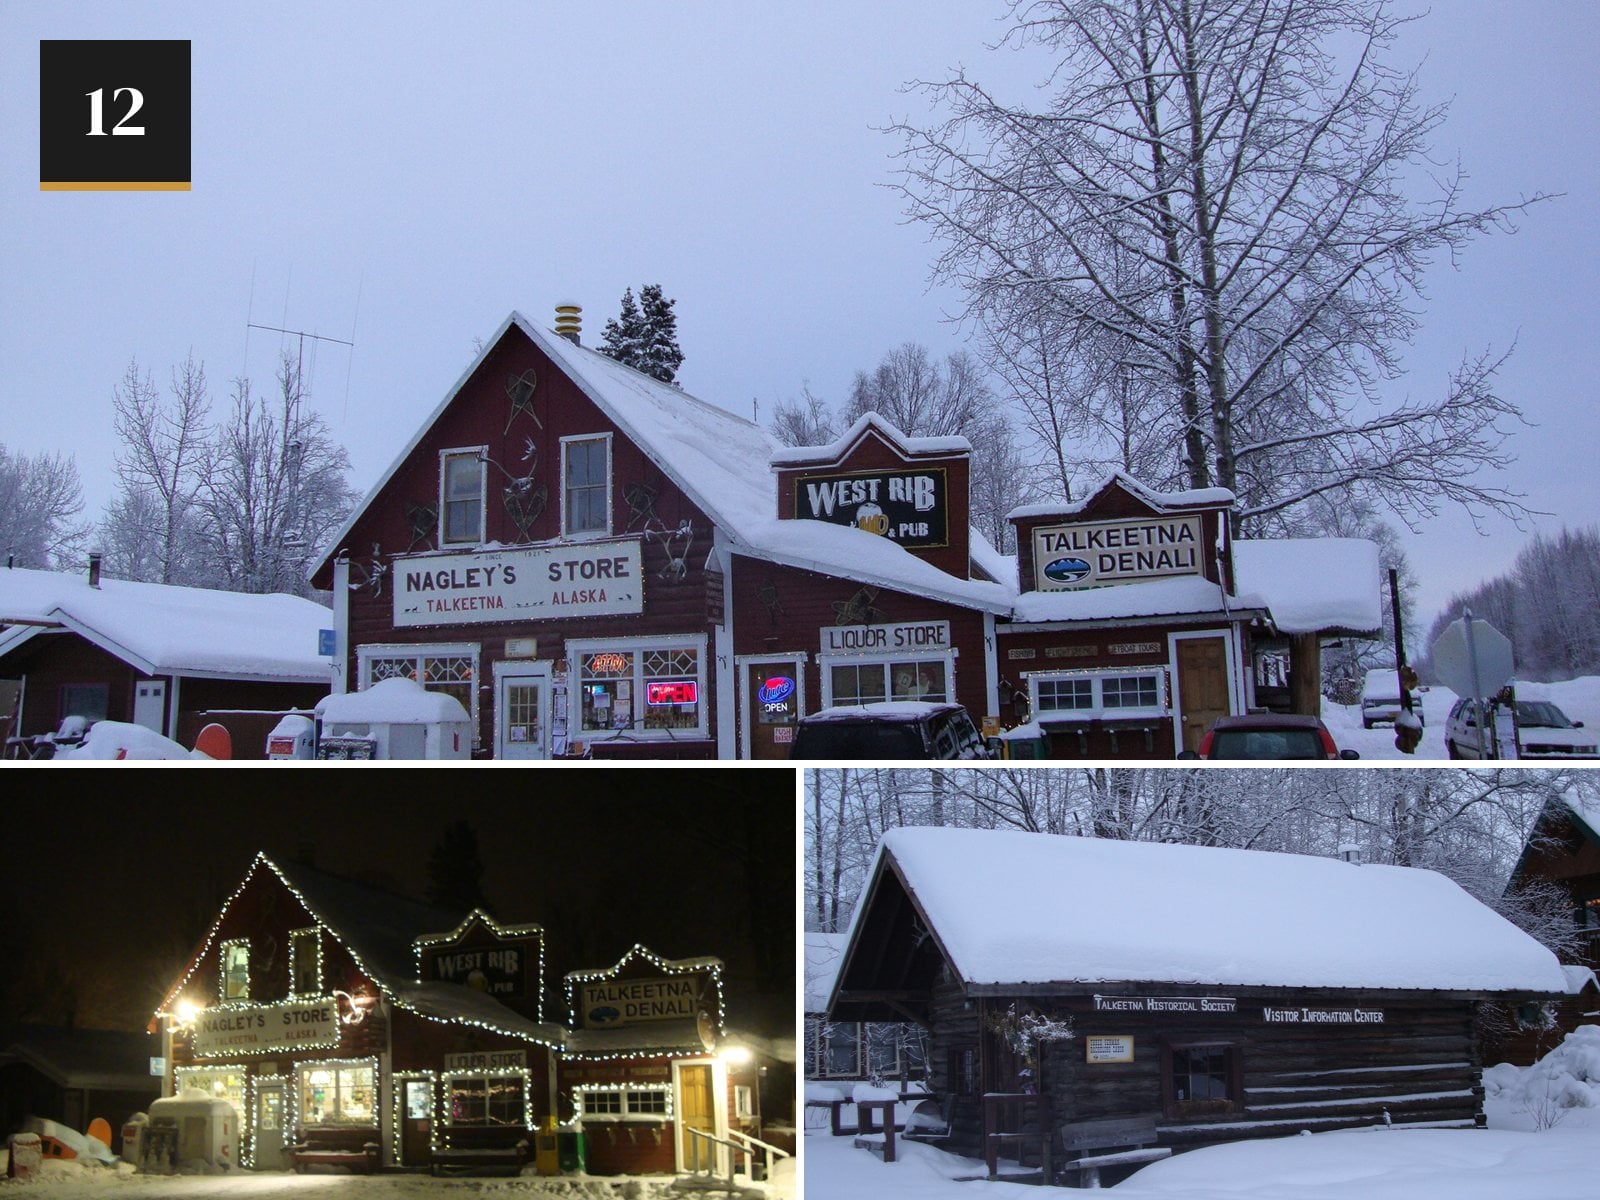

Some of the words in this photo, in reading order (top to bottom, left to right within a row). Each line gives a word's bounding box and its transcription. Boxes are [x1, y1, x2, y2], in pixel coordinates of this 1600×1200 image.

[806, 478, 882, 518] WEST
[888, 475, 936, 512] RIB
[888, 528, 897, 538] &
[899, 522, 929, 538] PUB
[1040, 523, 1196, 553] TALKEETNA
[1099, 547, 1196, 574] DENALI
[406, 563, 517, 593] NAGLEY'S
[548, 556, 630, 582] STORE
[426, 595, 505, 613] TALKEETNA
[551, 588, 608, 606] ALASKA
[829, 628, 887, 650] LIQUOR
[893, 624, 946, 648] STORE
[765, 703, 788, 712] OPEN
[437, 952, 484, 979] WEST
[488, 950, 519, 974] RIB
[586, 981, 693, 1002] TALKEETNA
[625, 999, 694, 1018] DENALI
[1094, 997, 1144, 1010] TALKEETNA
[1147, 998, 1198, 1011] HISTORICAL
[1200, 999, 1236, 1012] SOCIETY
[1354, 1009, 1384, 1023] CENTER
[203, 1014, 265, 1032] NAGLEY'S
[282, 1008, 331, 1026] STORE
